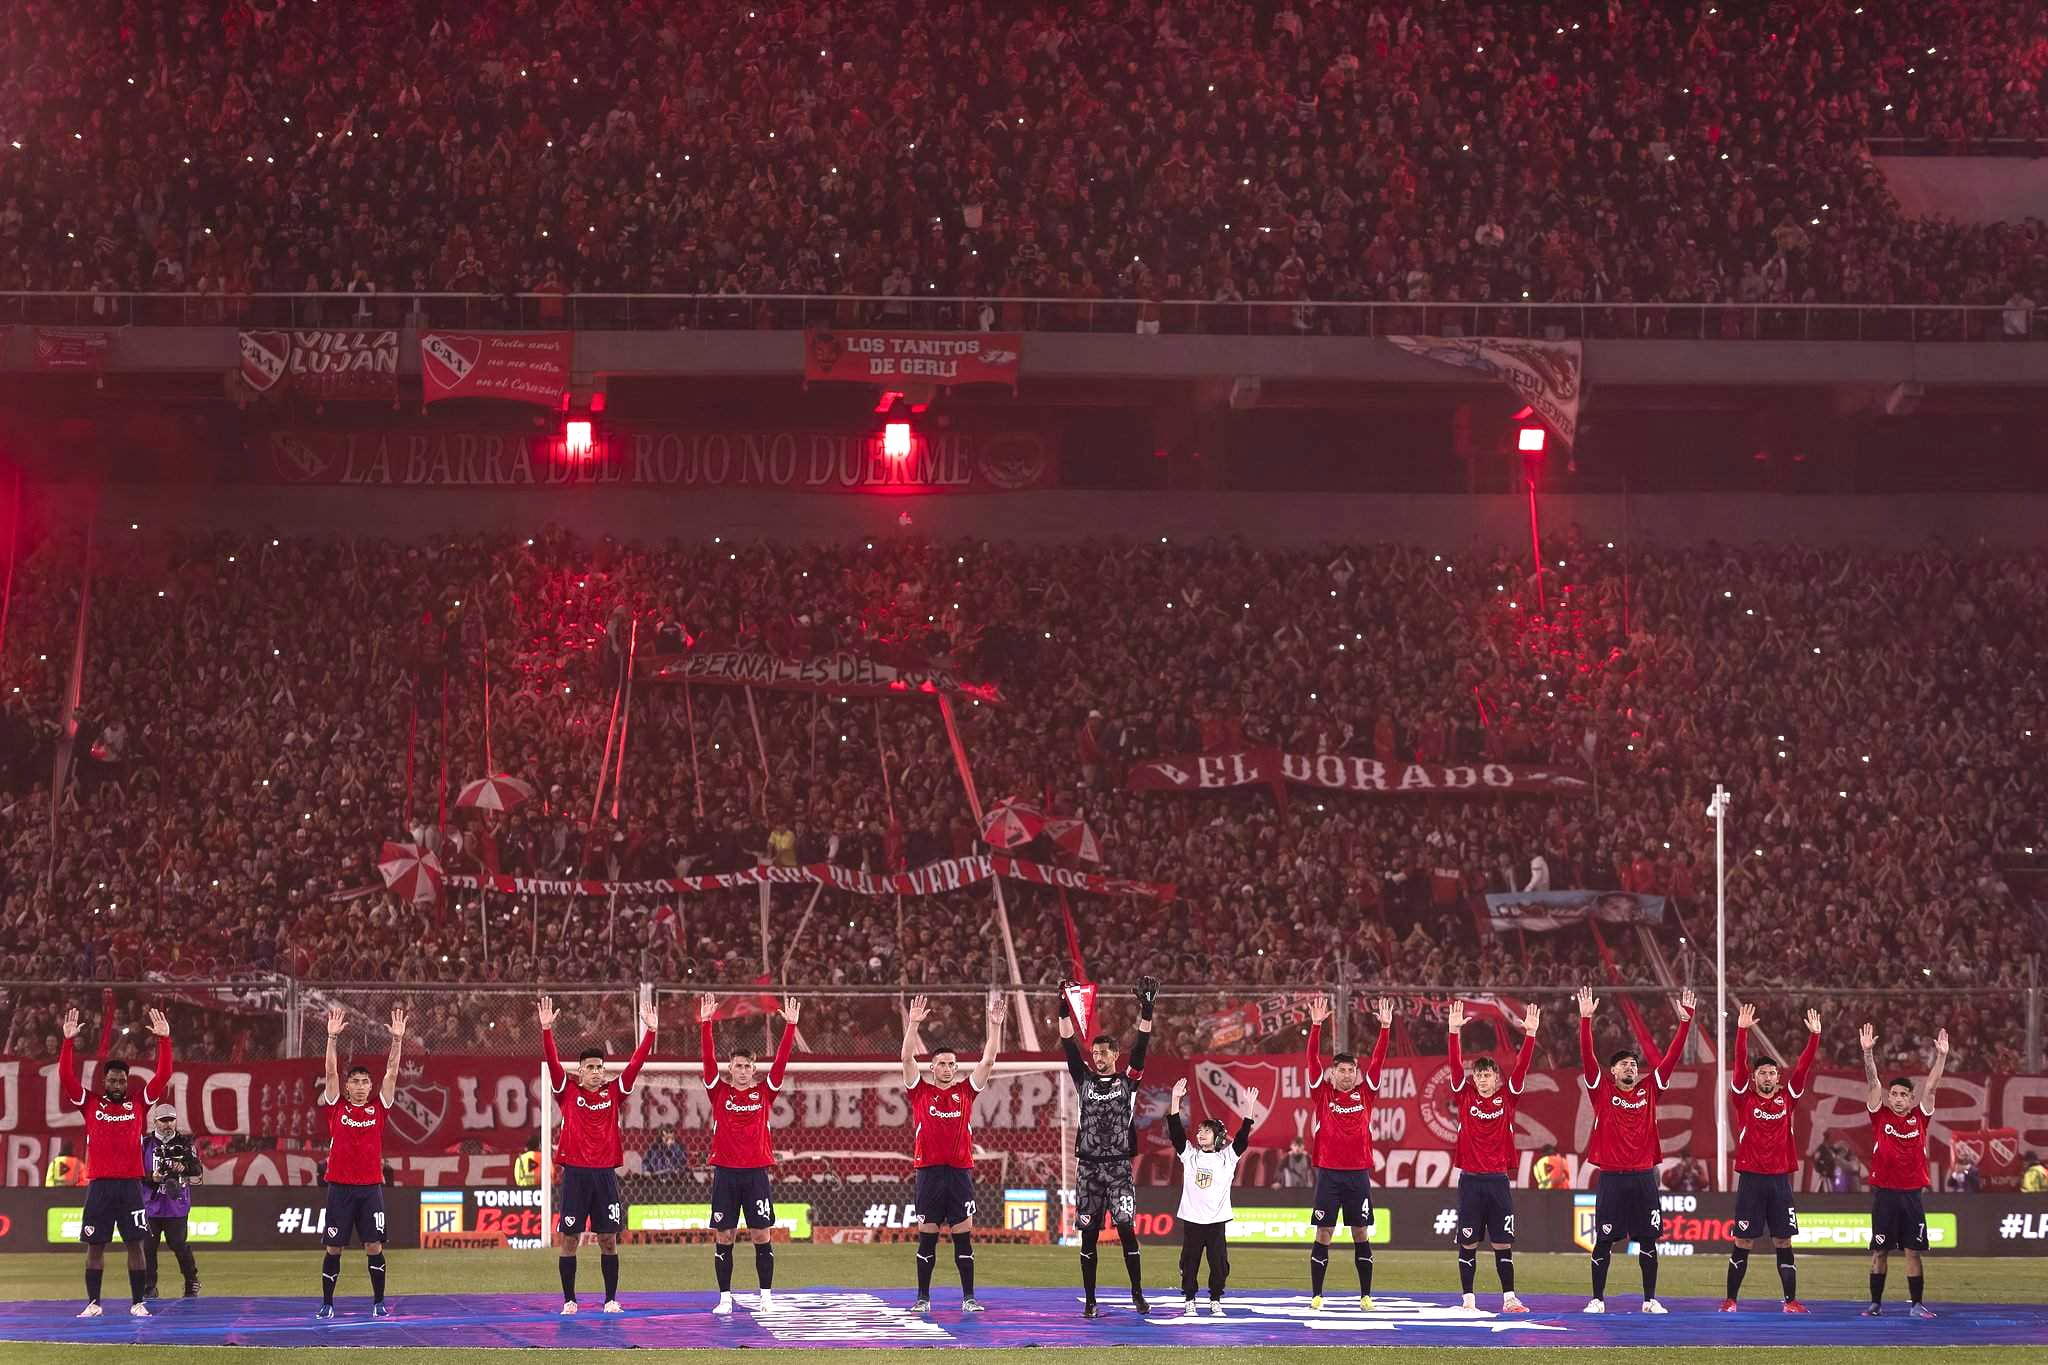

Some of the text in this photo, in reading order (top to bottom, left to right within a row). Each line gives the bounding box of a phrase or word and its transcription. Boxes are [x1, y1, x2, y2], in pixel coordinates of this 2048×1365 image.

[294, 331, 397, 352] VILLA
[847, 337, 981, 355] LOS TANITOS
[290, 347, 399, 374] LUJAN
[870, 358, 958, 377] DE GERLI
[340, 433, 392, 485] LA
[404, 433, 536, 485] BARRA
[631, 432, 732, 487] ROJO
[741, 432, 797, 486] NO
[806, 433, 973, 487] DUERME
[687, 653, 790, 684] BERNAL
[837, 651, 891, 687] DEL
[1198, 752, 1259, 788] EL
[1281, 1066, 1301, 1098] EL
[804, 1072, 864, 1130] DE
[473, 1189, 544, 1207] TORNEO
[755, 1198, 771, 1216] 34
[1119, 1195, 1134, 1212] 33
[131, 1208, 147, 1223] 77
[373, 1211, 385, 1229] 10
[608, 1202, 621, 1220] 36
